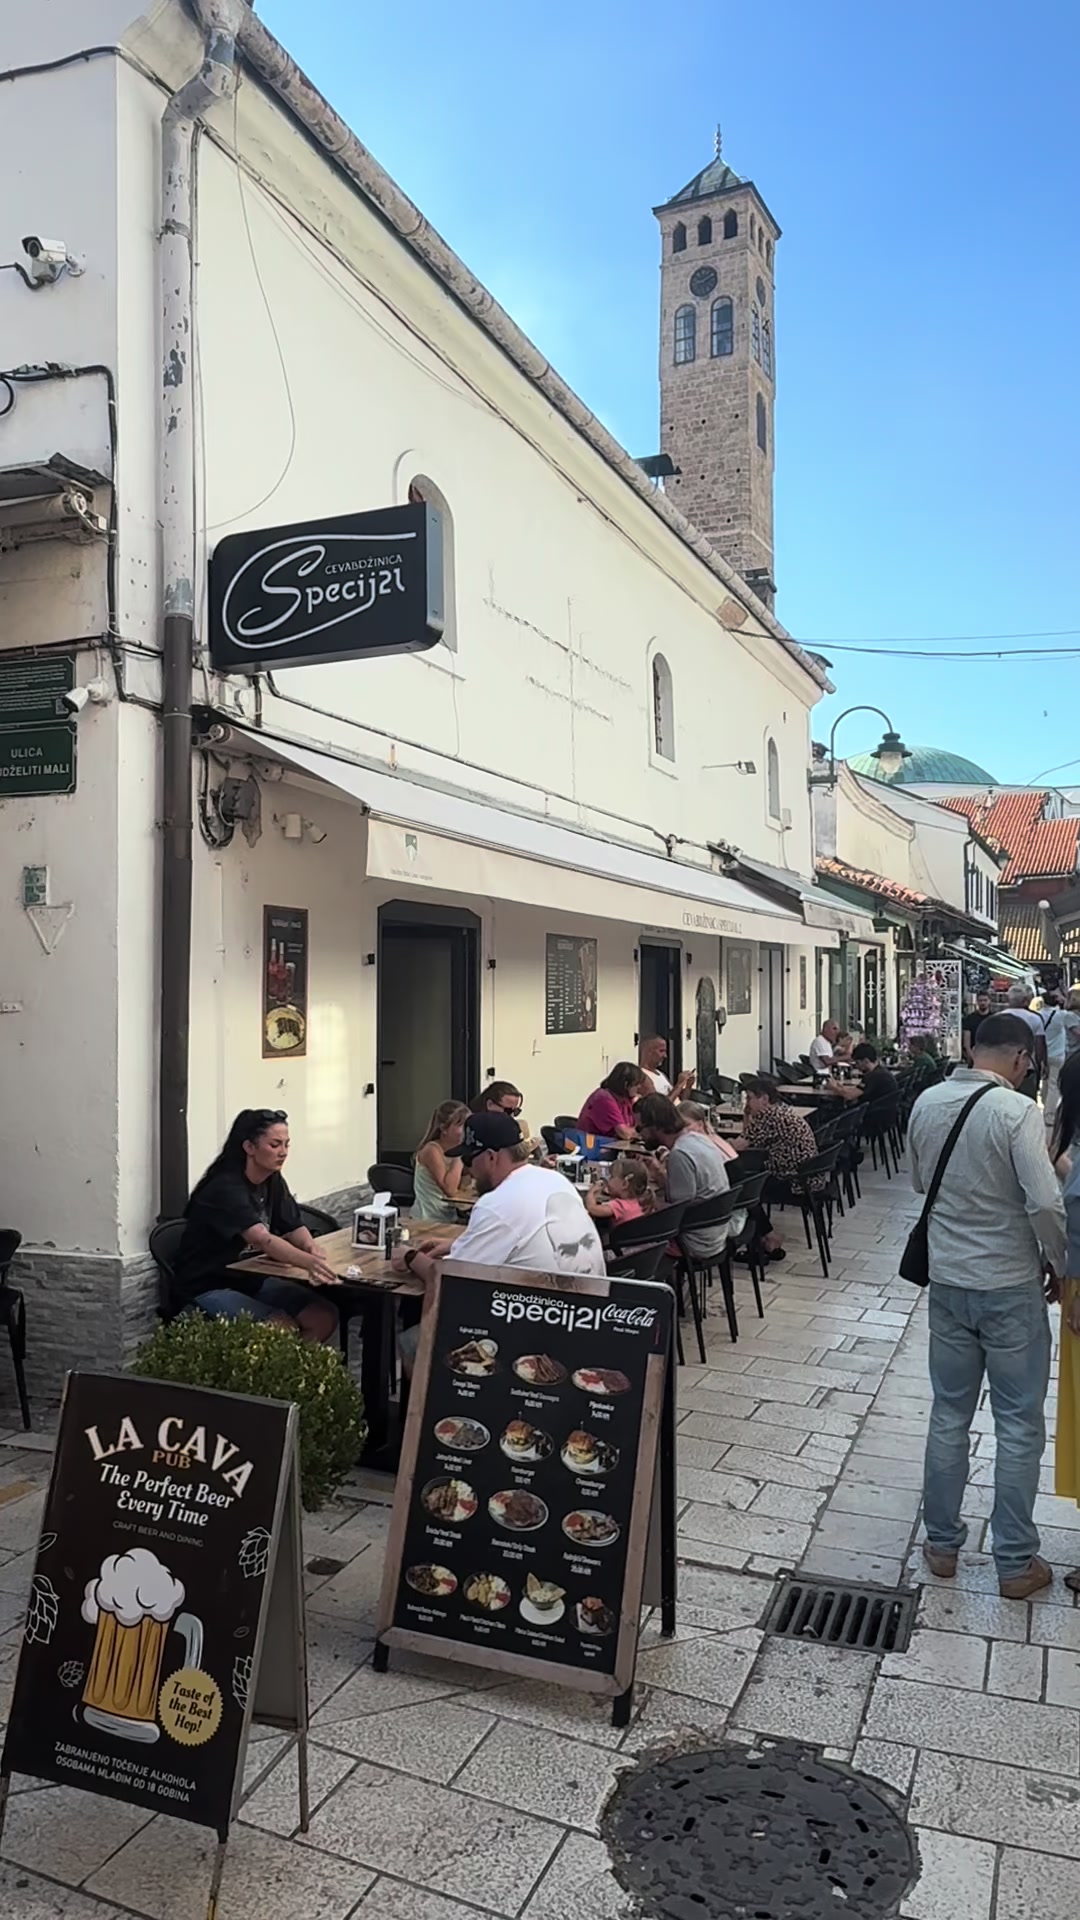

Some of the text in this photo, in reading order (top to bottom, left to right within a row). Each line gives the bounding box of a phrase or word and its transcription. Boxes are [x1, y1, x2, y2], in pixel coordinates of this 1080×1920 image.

[10, 747, 43, 758] ULICA
[43, 763, 70, 775] MALI
[84, 1415, 255, 1499] LA CAVA
[151, 1450, 192, 1469] PUB
[100, 1463, 234, 1509] The Perfect Beer
[117, 1490, 209, 1527] Every Time
[112, 1520, 204, 1548] CRAFT BEER AND DINING
[173, 1681, 216, 1707] Taste of
[168, 1697, 213, 1720] the Best
[174, 1713, 203, 1735] Hop!
[54, 1741, 197, 1791] ZABRANJENO TOČENJE ALKOHOLA
[55, 1754, 97, 1776] OSOBAMA
[132, 1778, 146, 1791] OD
[146, 1781, 157, 1793] 18
